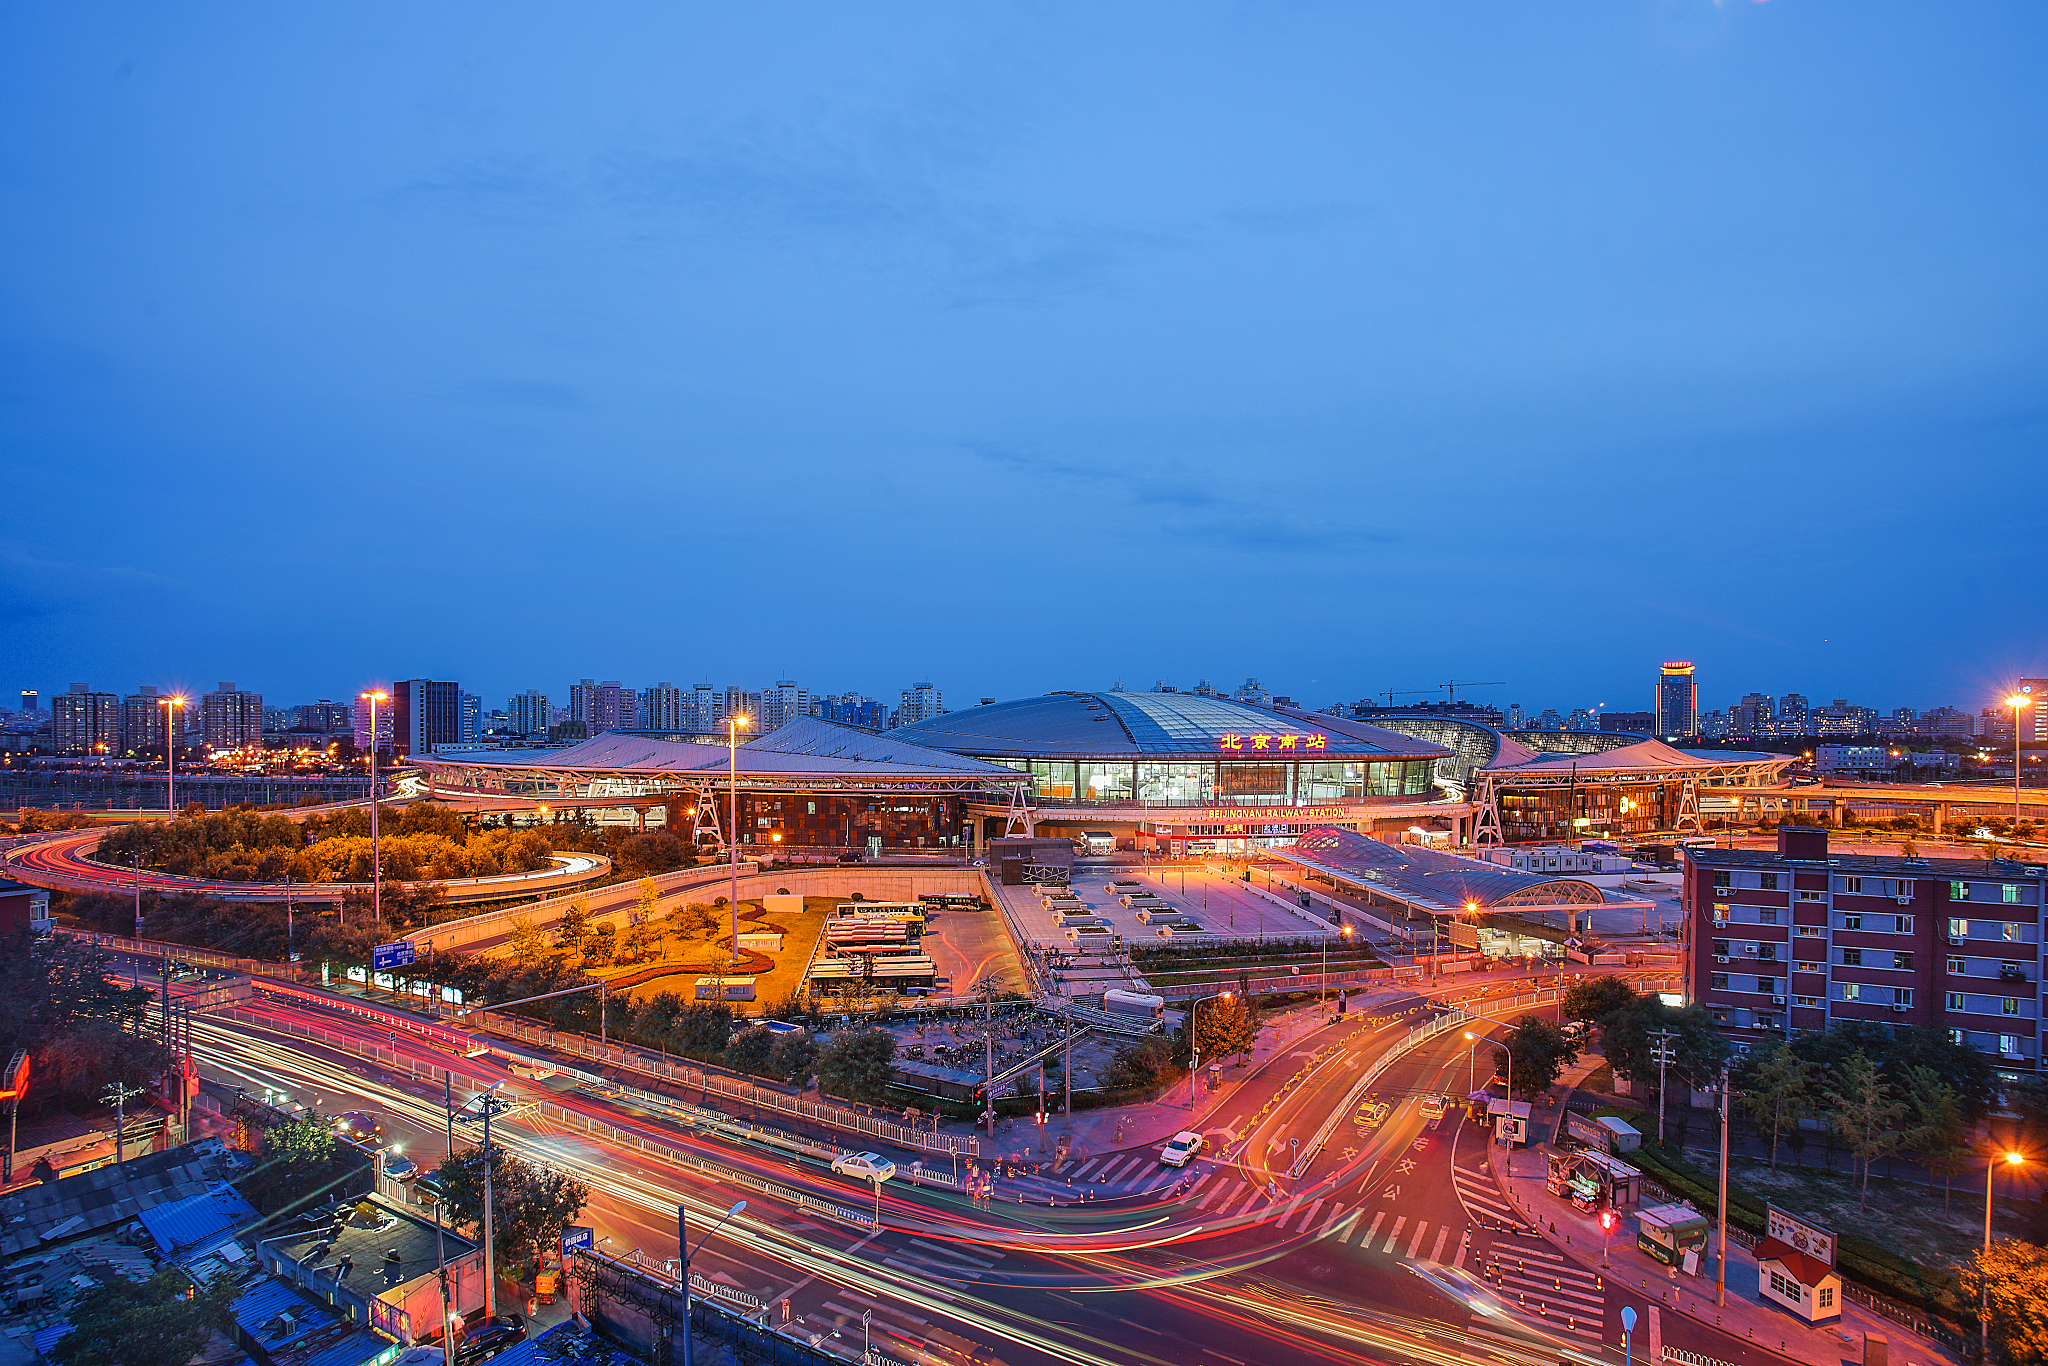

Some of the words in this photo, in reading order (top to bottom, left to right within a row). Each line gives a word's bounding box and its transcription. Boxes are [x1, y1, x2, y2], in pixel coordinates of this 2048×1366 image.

[1220, 733, 1327, 750] 北京南站
[1208, 809, 1262, 819] BEIJINGNAN
[1266, 808, 1304, 818] RAILWAY
[1309, 807, 1345, 817] STATION
